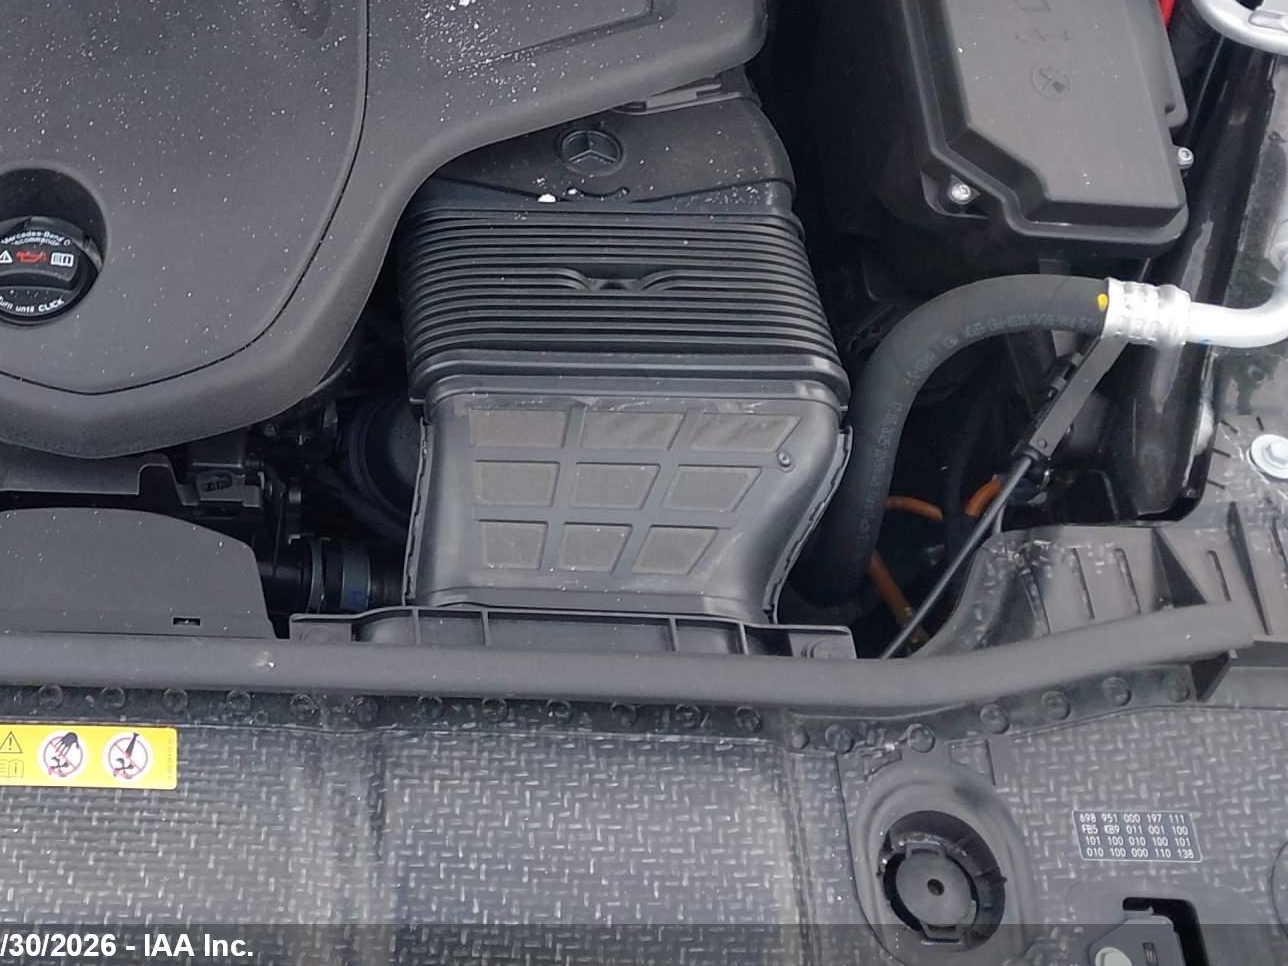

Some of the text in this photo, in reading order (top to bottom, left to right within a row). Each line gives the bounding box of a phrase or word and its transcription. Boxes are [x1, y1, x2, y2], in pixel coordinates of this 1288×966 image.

[15, 305, 35, 313] until
[38, 297, 64, 312] CLICK
[1101, 813, 1118, 823] 951
[1123, 813, 1141, 823] 000
[1147, 813, 1162, 823] 197
[1169, 814, 1185, 824] 111
[1126, 825, 1143, 835] 011
[1148, 825, 1165, 835] 001
[1172, 825, 1188, 836] 100
[1085, 836, 1191, 847] 101 100 010 100 101
[1086, 847, 1104, 857] 010
[1110, 847, 1126, 858] 100
[1131, 847, 1149, 858] 000
[1154, 848, 1171, 858] 110
